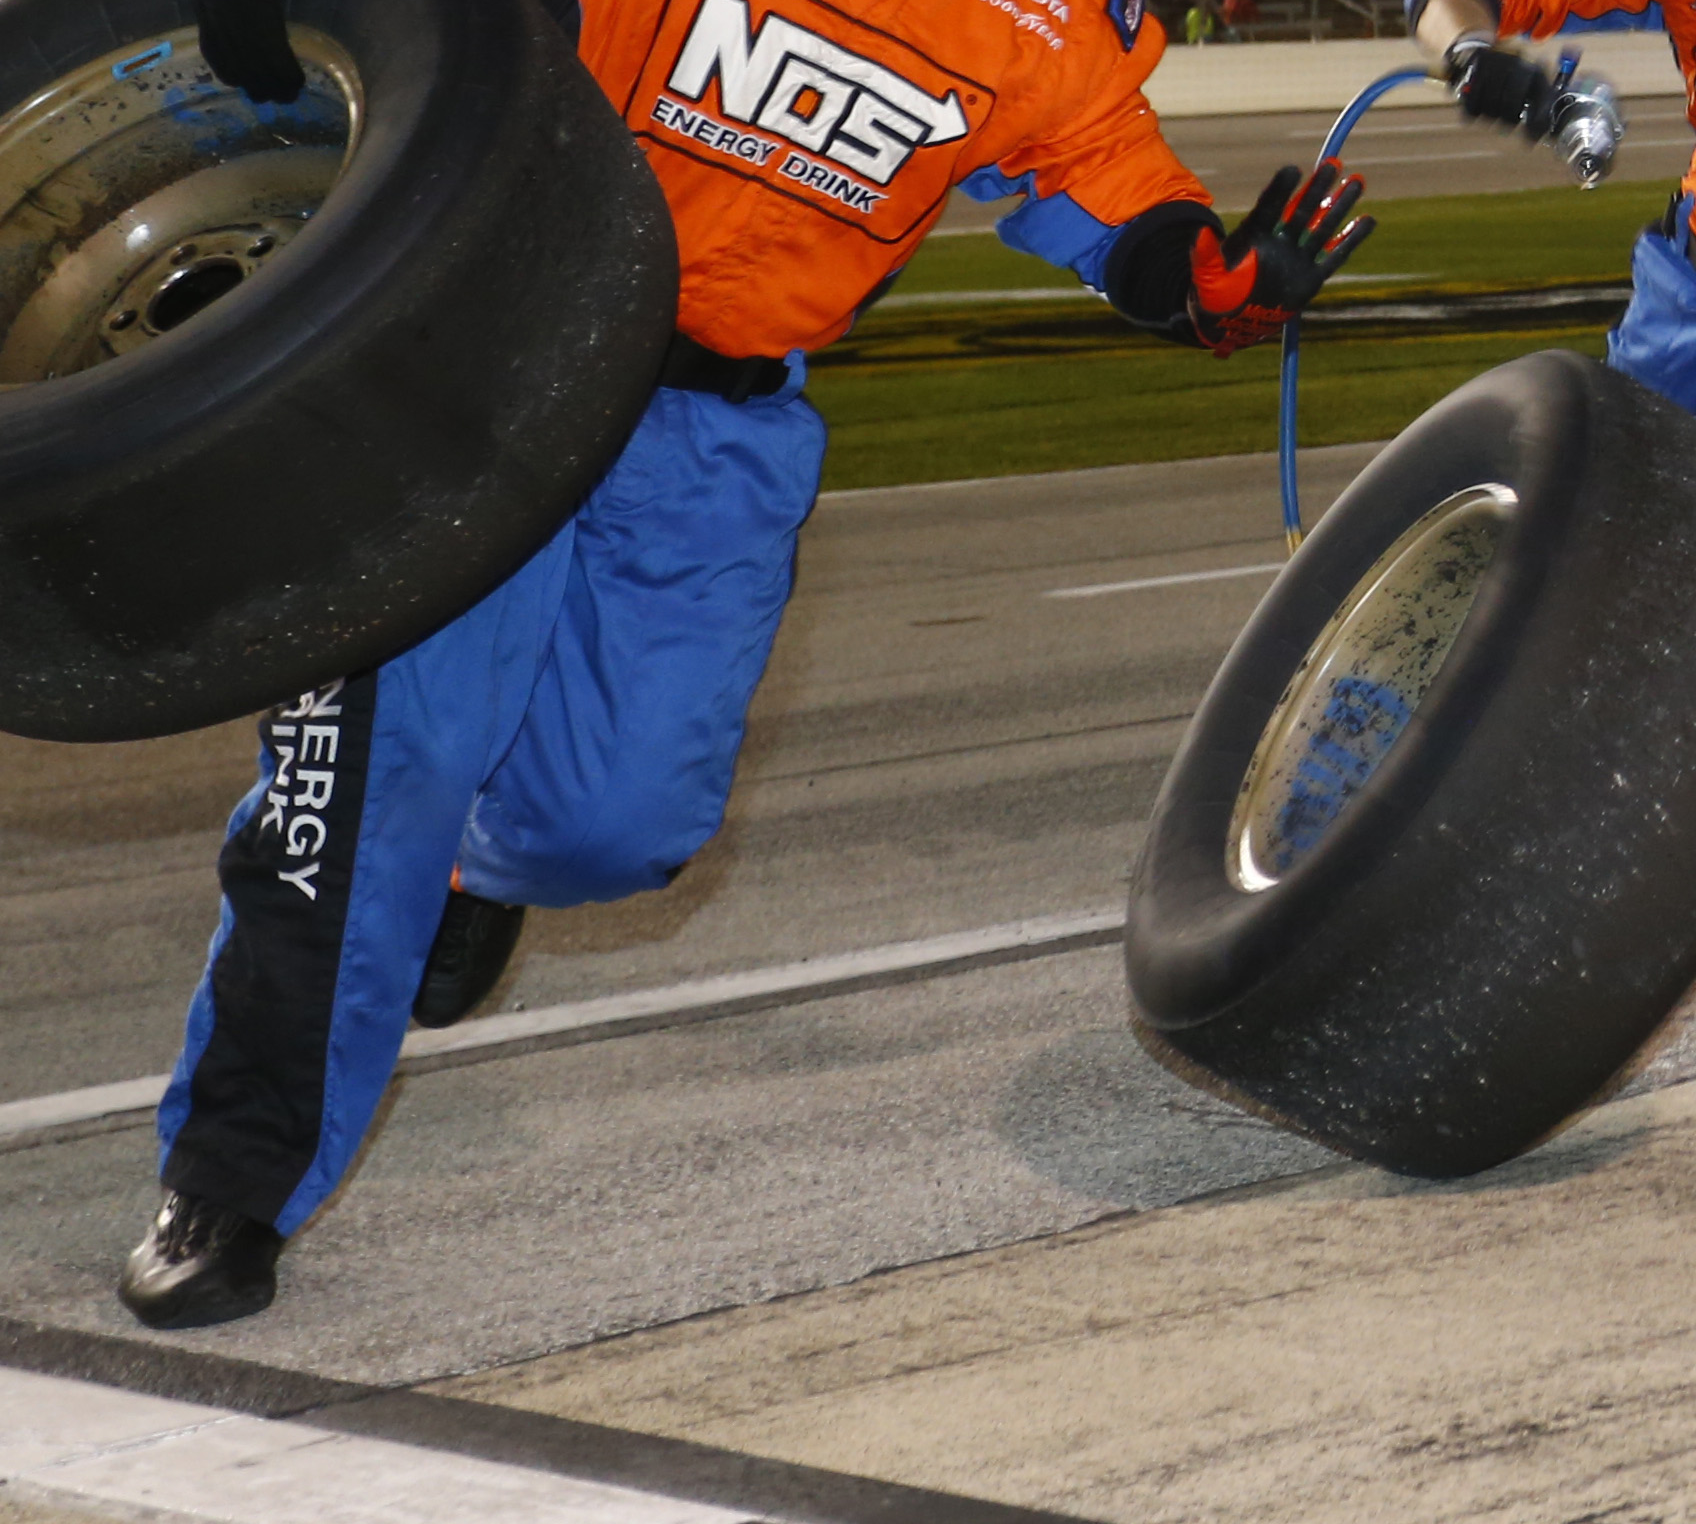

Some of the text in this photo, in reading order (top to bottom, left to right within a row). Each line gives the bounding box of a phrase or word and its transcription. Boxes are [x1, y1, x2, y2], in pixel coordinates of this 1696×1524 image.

[651, 96, 890, 214] ENERGY DRINK
[260, 690, 316, 834] RINK
[278, 676, 346, 901] NERGY
